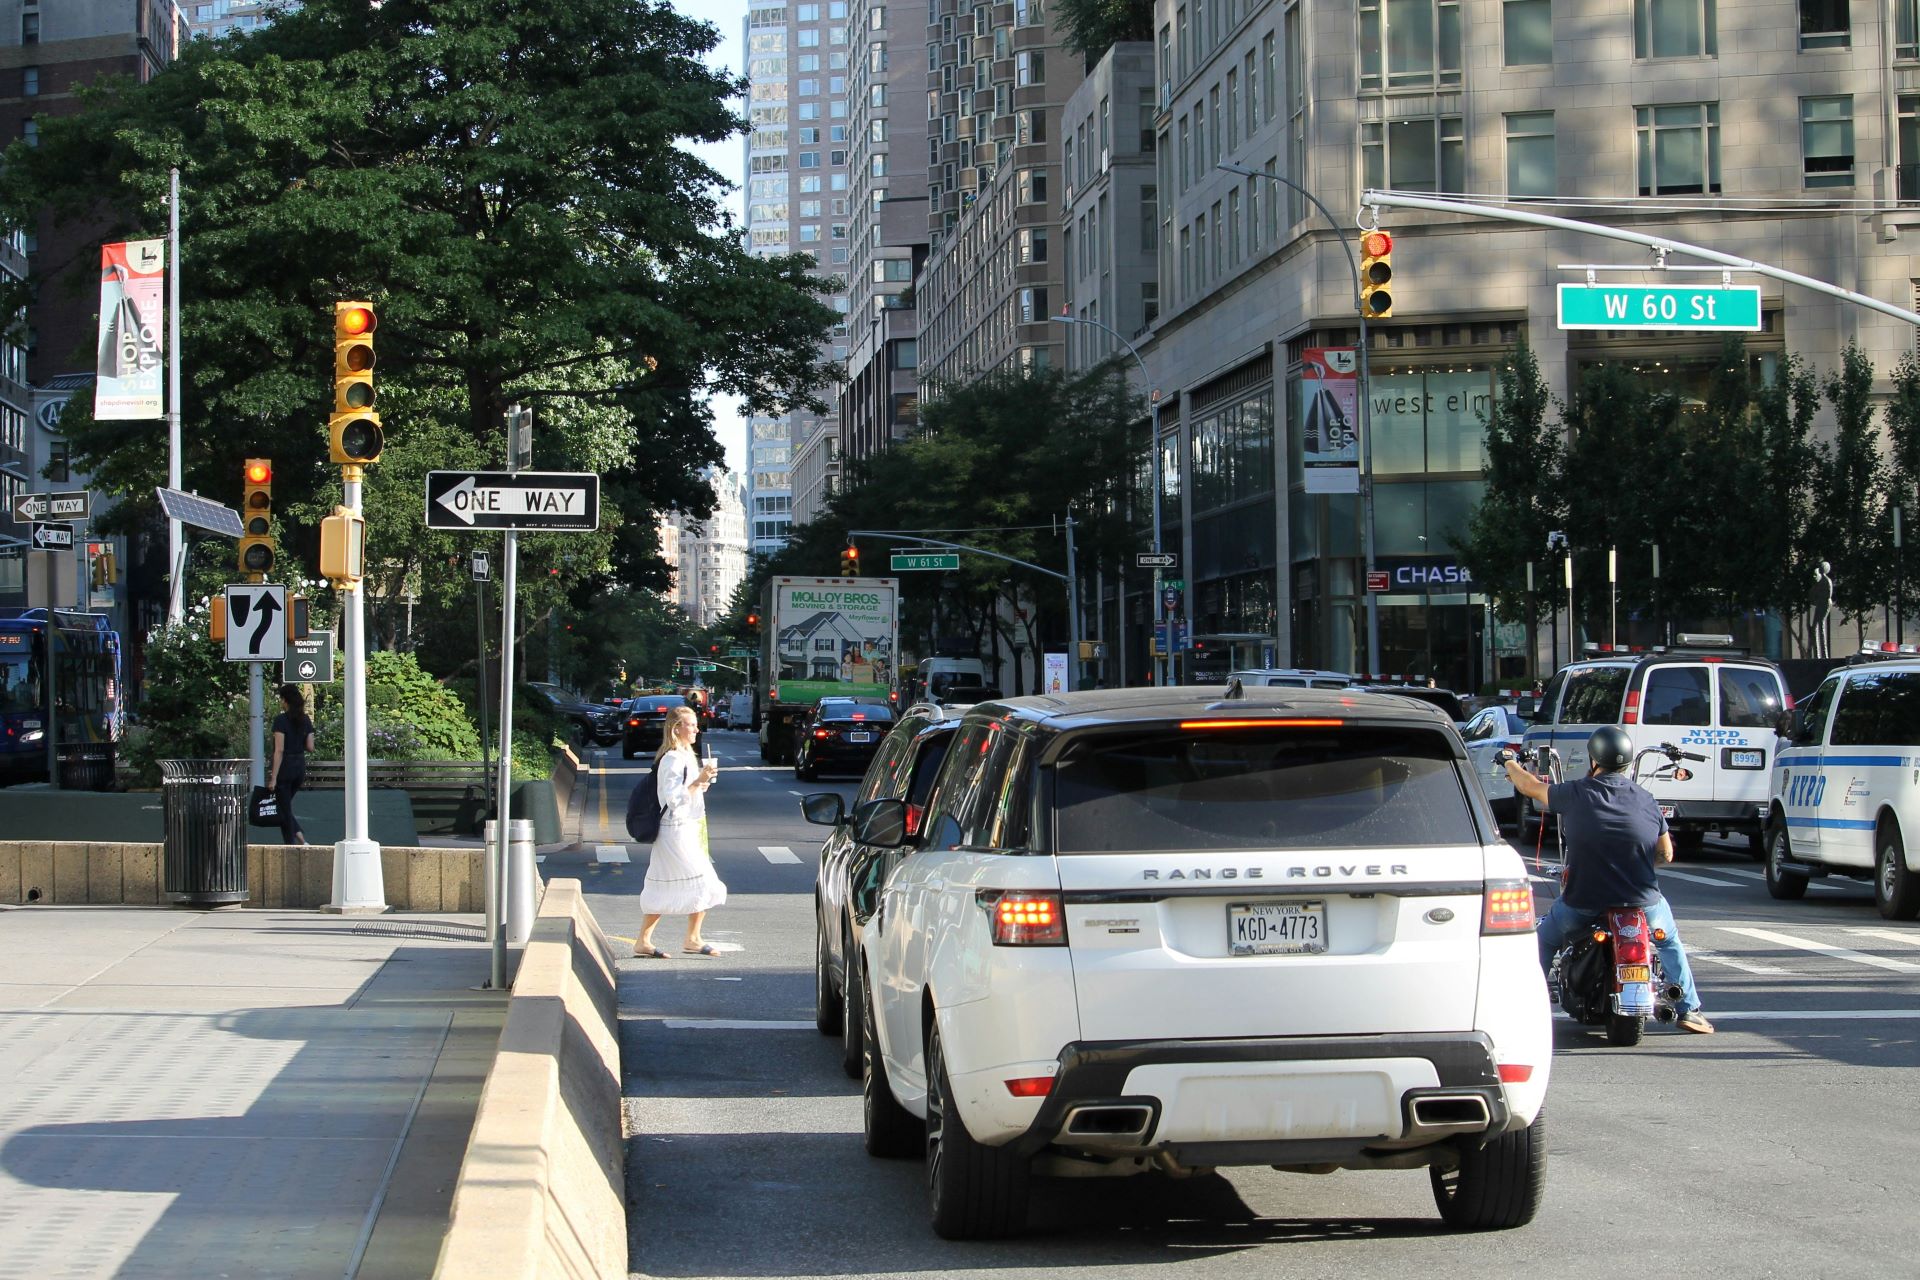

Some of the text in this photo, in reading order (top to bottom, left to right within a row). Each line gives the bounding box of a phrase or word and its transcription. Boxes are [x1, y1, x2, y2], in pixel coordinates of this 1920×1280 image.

[1604, 294, 1716, 320] W 60 St
[1374, 391, 1491, 414] west elm
[26, 500, 78, 514] ONE WAY
[454, 489, 575, 512] ONE WAY
[38, 530, 69, 543] ONE WAY
[907, 557, 943, 567] W 61 St
[791, 591, 881, 604] MOLLOY BROS.
[791, 602, 825, 610] MOVING
[837, 603, 878, 611] STORAGE
[1689, 729, 1741, 738] NYPD
[1681, 737, 1748, 746] POLICE
[1734, 754, 1755, 763] 8997
[1789, 775, 1827, 807] NYPD
[1143, 865, 1408, 880] RANGE ROVER
[1252, 907, 1301, 915] NEW YORK
